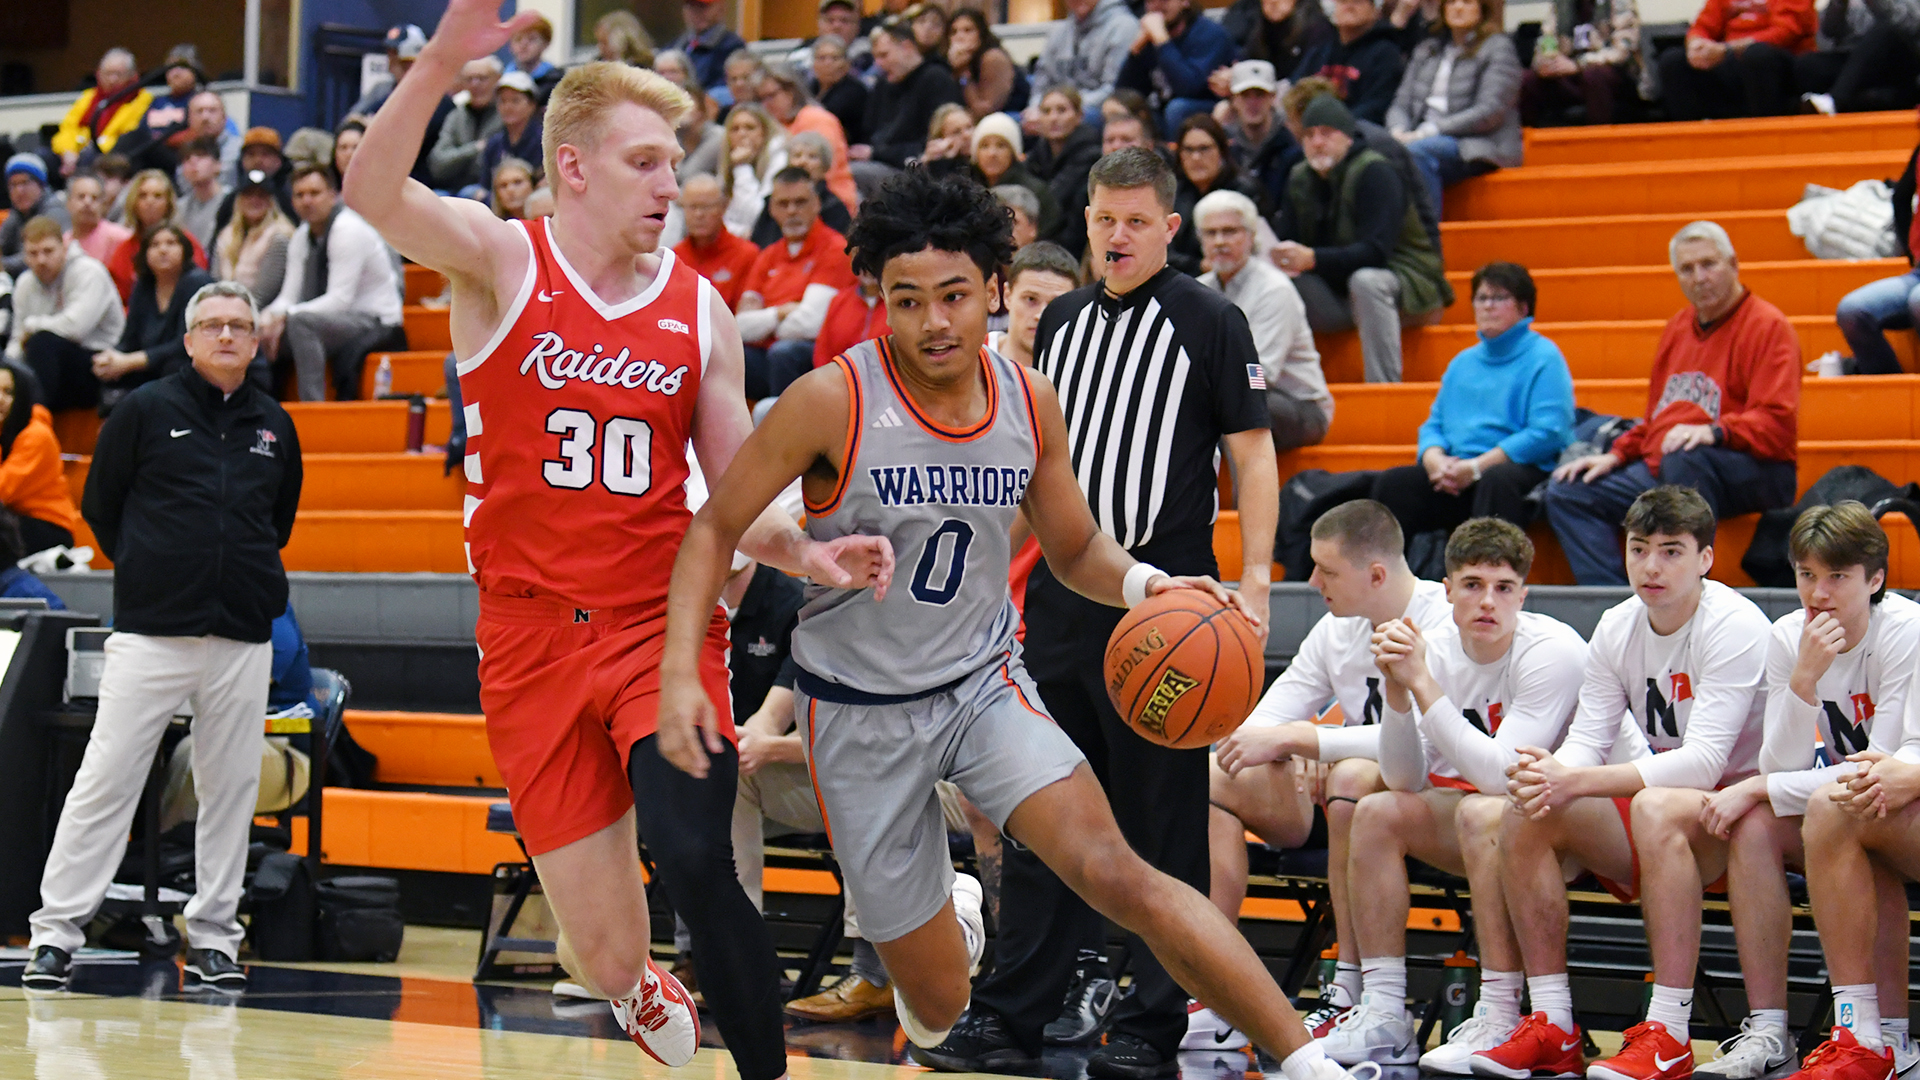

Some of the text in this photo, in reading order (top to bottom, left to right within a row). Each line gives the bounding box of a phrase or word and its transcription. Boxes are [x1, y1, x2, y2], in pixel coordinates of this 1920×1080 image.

[658, 319, 689, 334] GPAC
[519, 331, 689, 396] Raiders
[541, 407, 653, 498] 30
[868, 464, 1030, 508] WARRIORS
[908, 517, 977, 608] 0
[1138, 667, 1198, 738] NAIA
